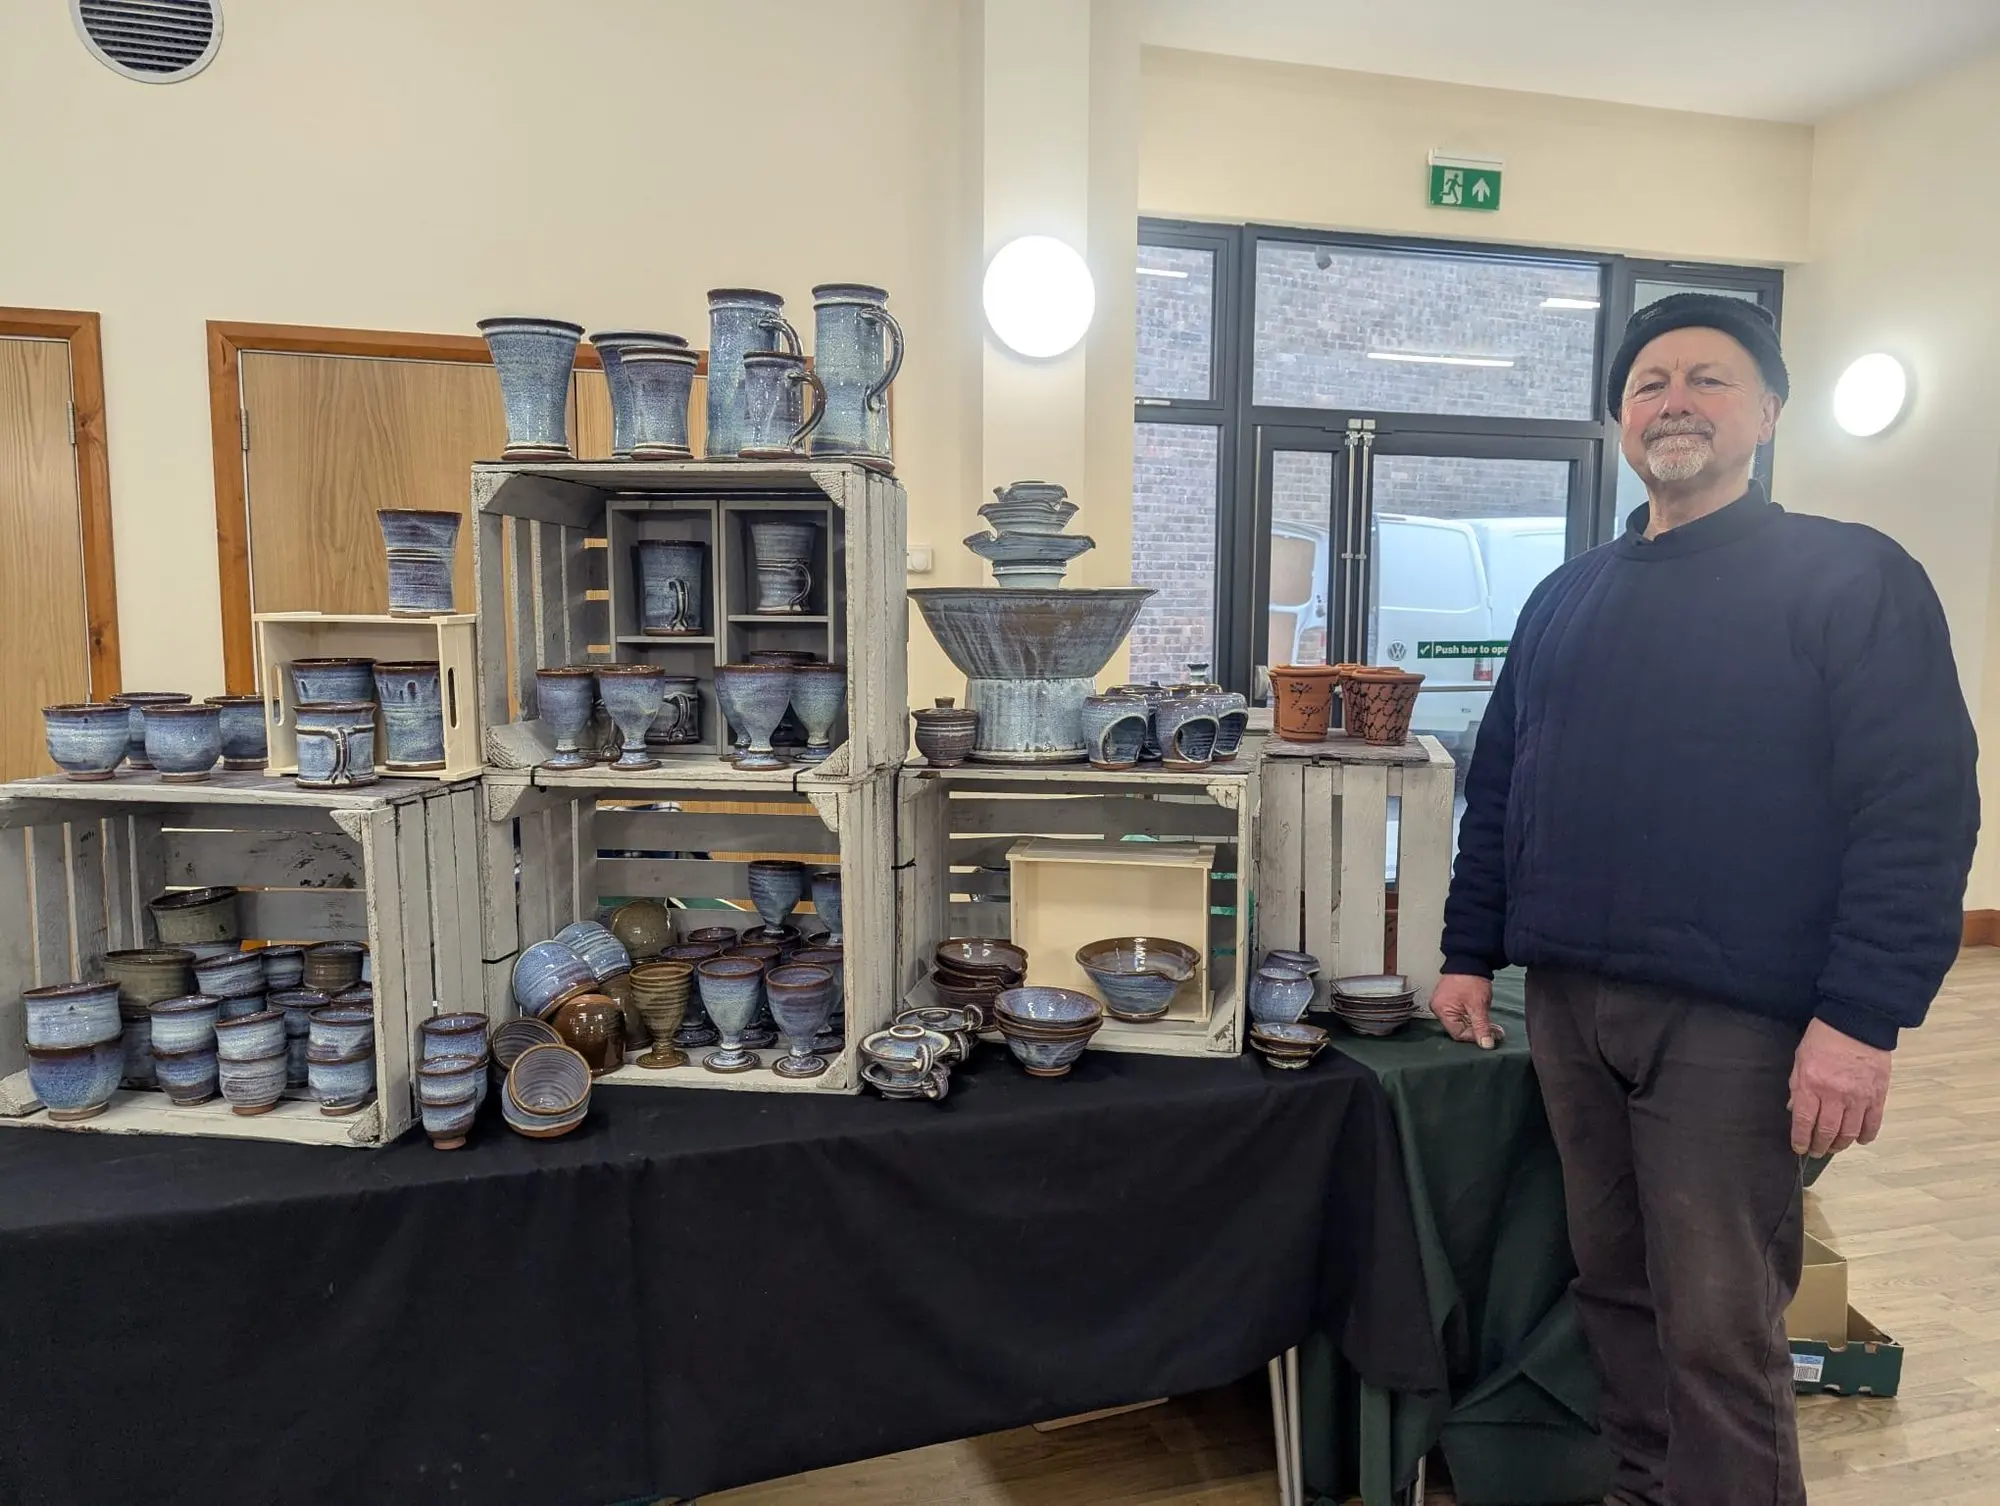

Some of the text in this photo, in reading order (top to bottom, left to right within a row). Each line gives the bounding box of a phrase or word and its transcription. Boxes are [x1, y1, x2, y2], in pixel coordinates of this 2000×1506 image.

[1387, 641, 1406, 661] VW
[1435, 645, 1509, 656] Push bar to ope
